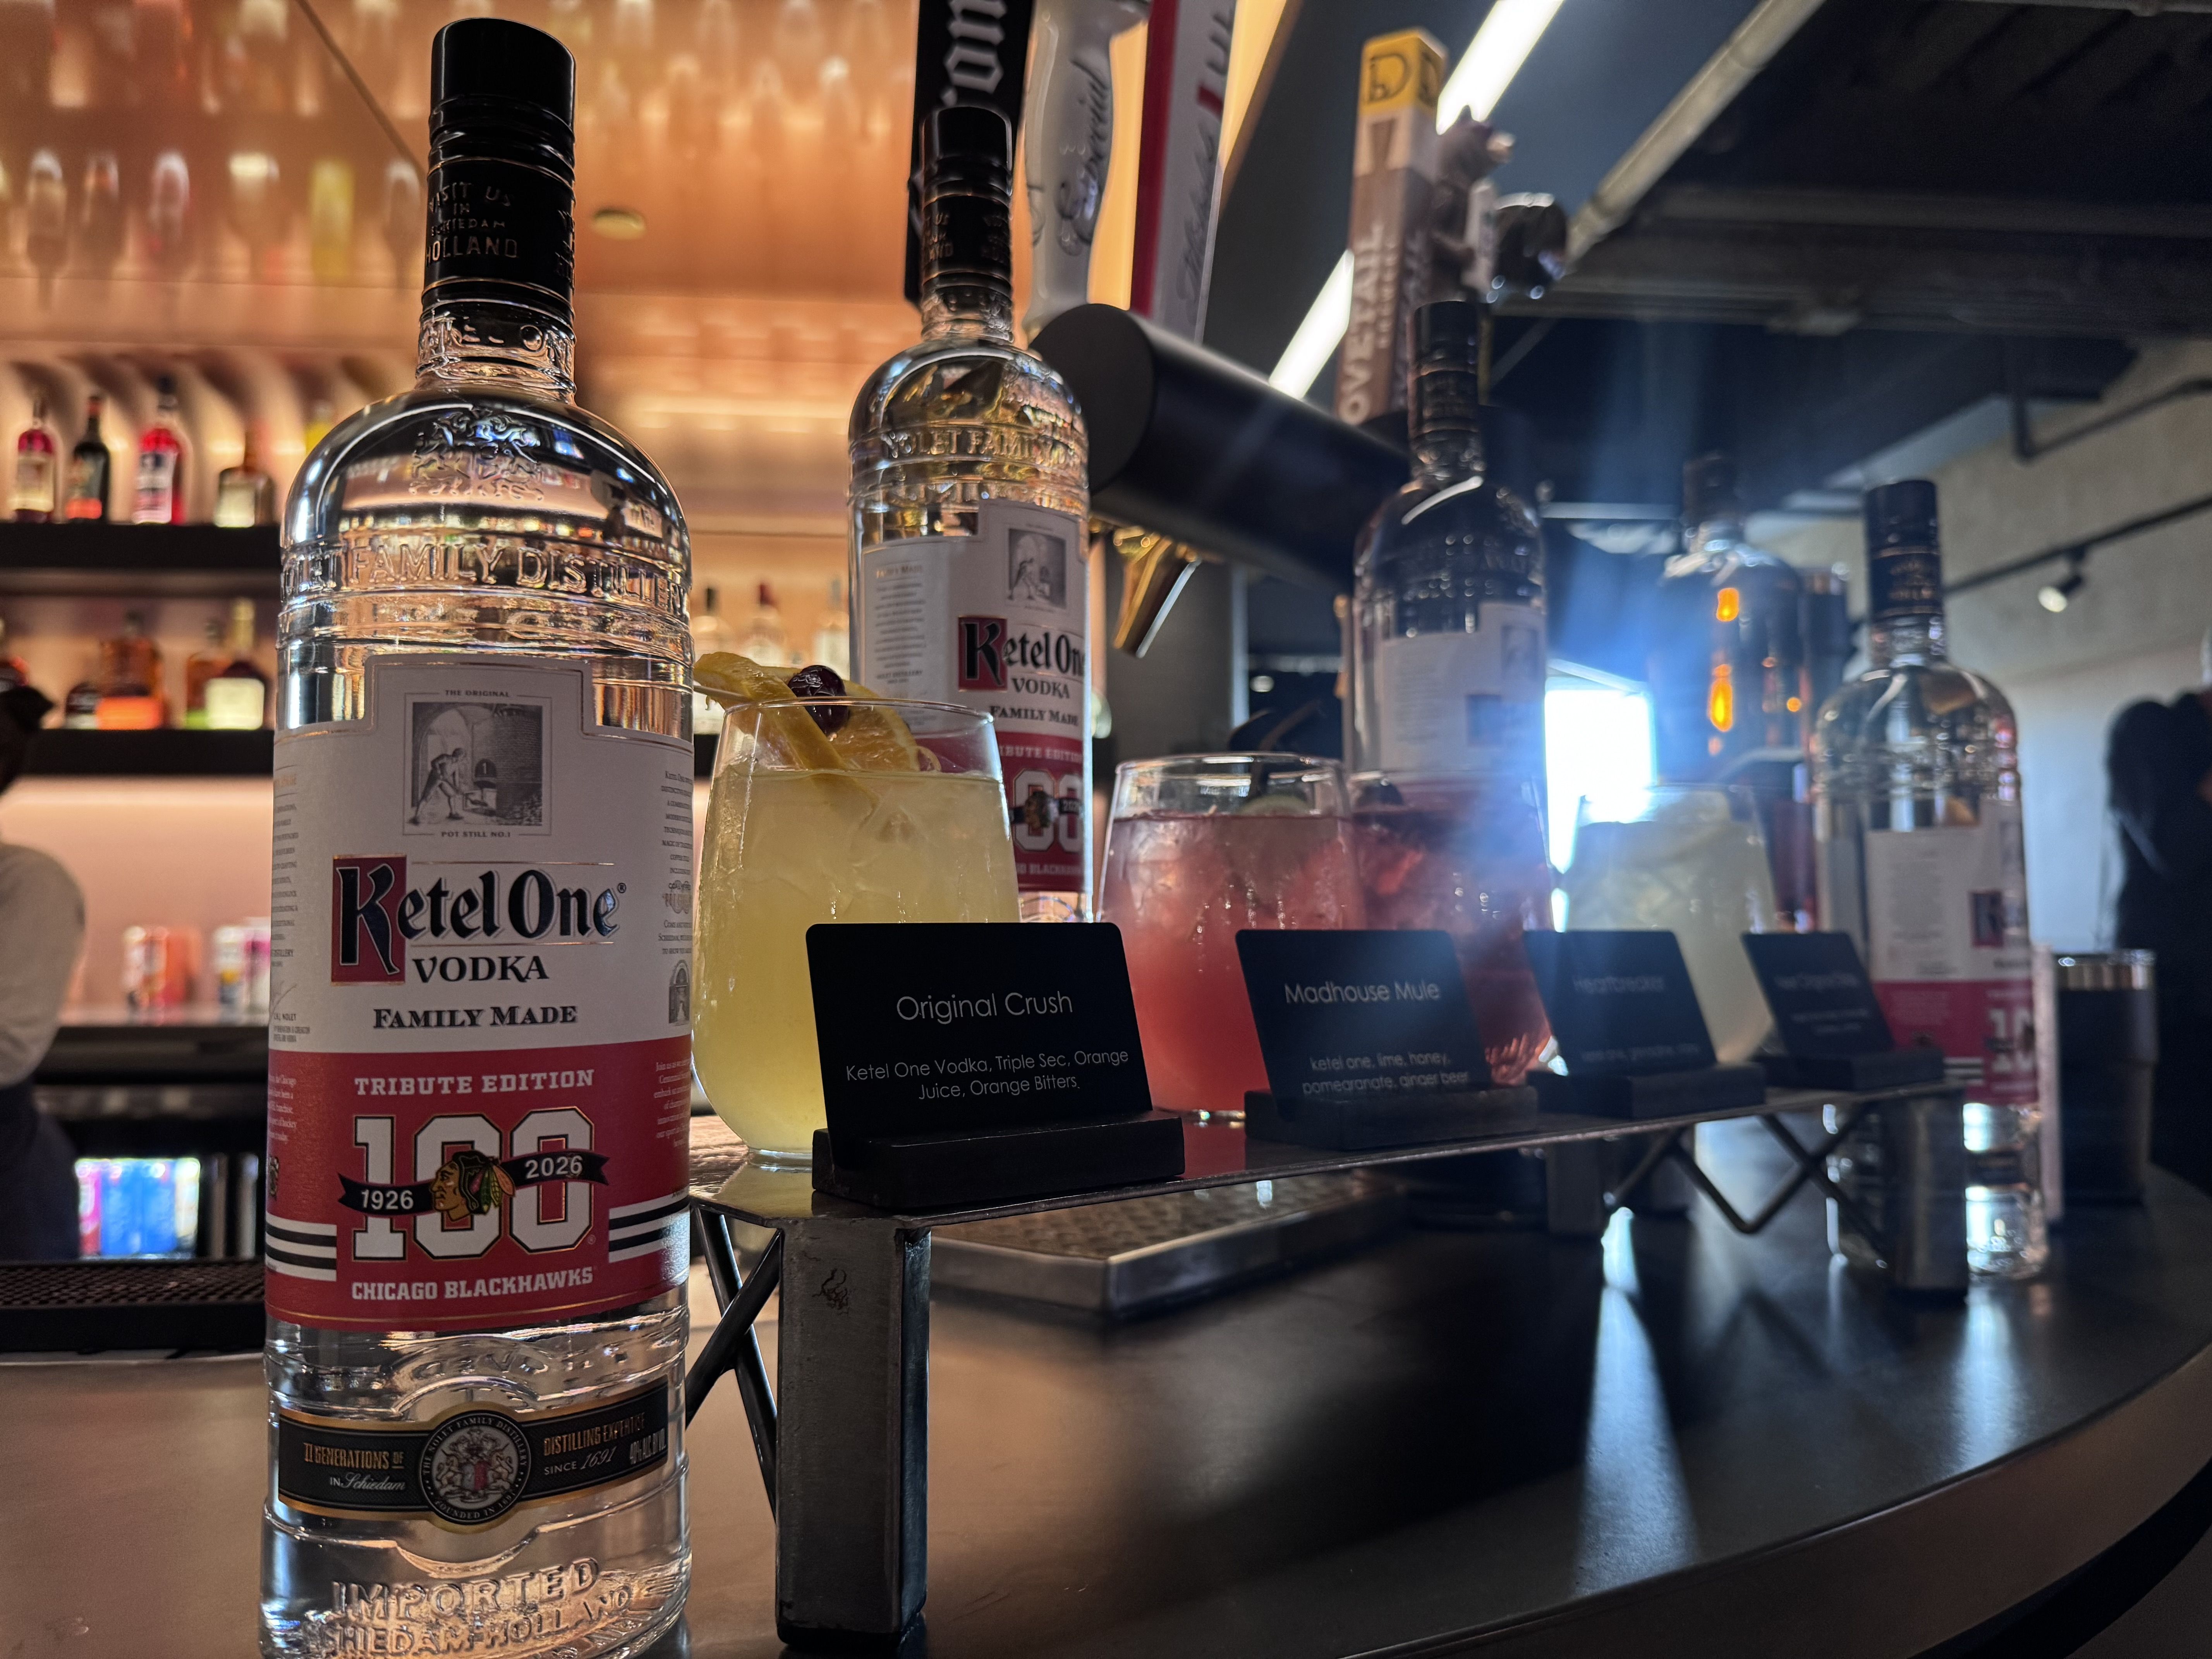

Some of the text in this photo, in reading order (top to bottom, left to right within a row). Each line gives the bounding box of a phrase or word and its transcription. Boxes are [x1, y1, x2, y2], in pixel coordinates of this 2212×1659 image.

[426, 235, 518, 264] HOLLAND
[349, 543, 503, 585] FAMILY
[1011, 677, 1070, 699] VODKA
[336, 863, 500, 975] Ketel
[412, 955, 549, 984] VODKA
[1284, 979, 1441, 1005] Madhouse Mule
[373, 1005, 579, 1030] FAMILY MADE
[896, 990, 1073, 1025] Original Crush
[846, 1049, 1129, 1081] Ketel One Vodka, Triple Sec, Orange
[1309, 1054, 1344, 1072] ketel
[354, 1069, 595, 1096] TRIBUTE EDITION
[918, 1082, 966, 1100] Juice,
[969, 1077, 1030, 1096] Orange
[525, 1154, 584, 1180] 2026
[352, 1106, 594, 1262] 100
[361, 1188, 414, 1211] 1926
[351, 1266, 594, 1301] CHICAGO BLACKHAWKS
[422, 1417, 528, 1475] THE NOLET FAMILY DISTILLERY
[543, 1426, 601, 1456] DISTILLING
[314, 1445, 390, 1470] GENERATIONS
[392, 1451, 405, 1464] OF
[544, 1445, 617, 1475] SINCE 1691
[330, 1472, 406, 1491] IN Schiedam
[434, 1500, 481, 1520] FOUNDED
[484, 1508, 496, 1516] IN
[332, 1557, 601, 1623] IMPORTED
